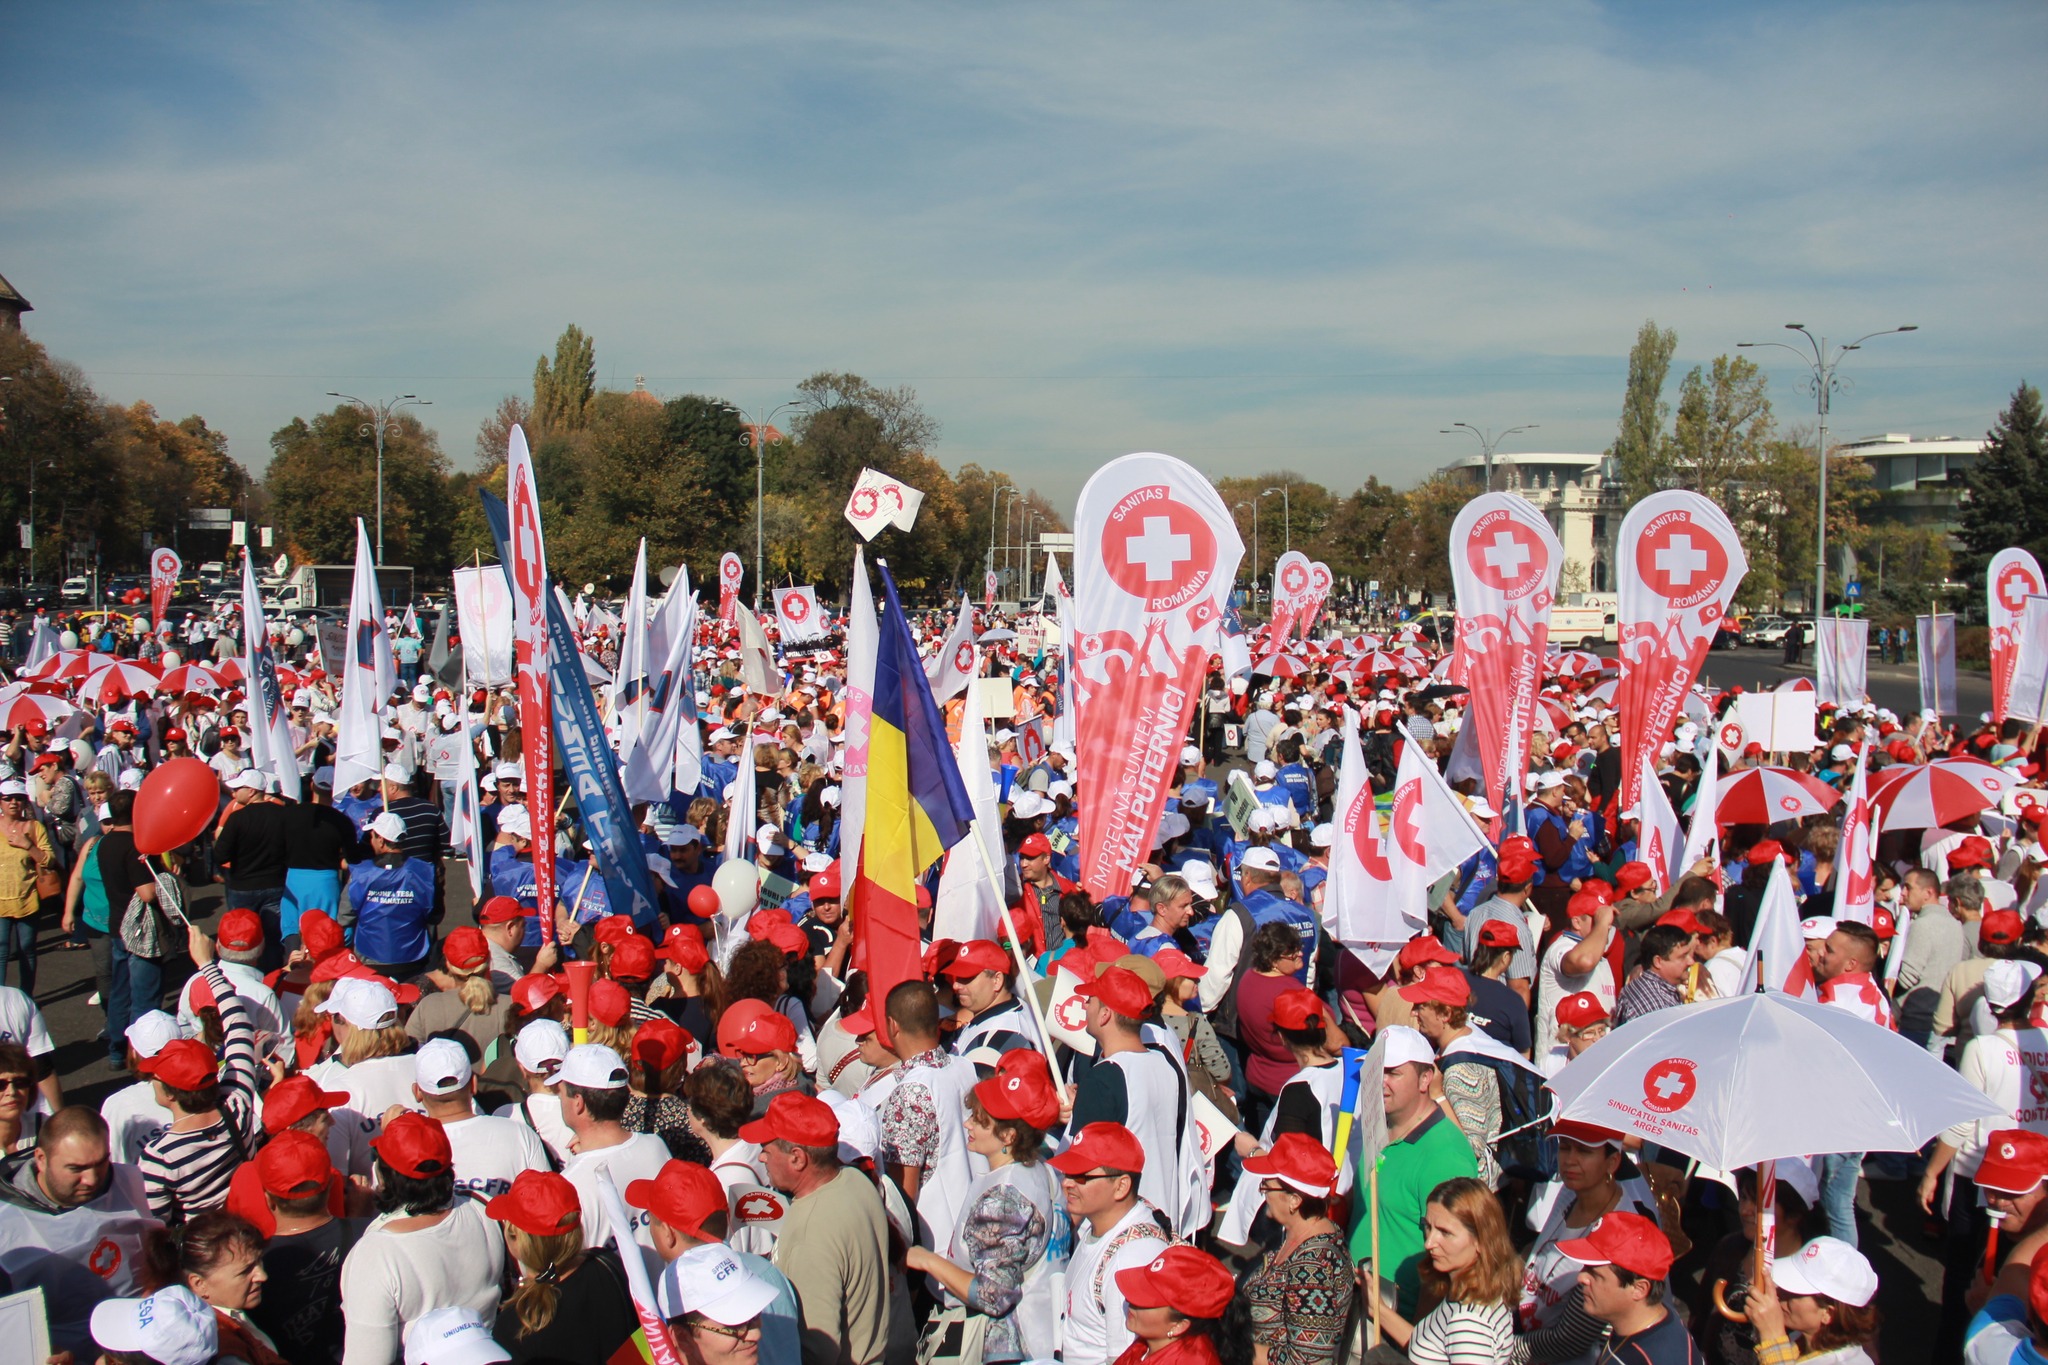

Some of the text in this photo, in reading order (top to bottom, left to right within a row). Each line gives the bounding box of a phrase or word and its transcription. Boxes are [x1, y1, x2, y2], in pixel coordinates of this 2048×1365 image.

[1113, 487, 1163, 522] SANITAS
[1472, 511, 1506, 538] SANITAS
[1645, 512, 1686, 538] SANITAS
[1152, 570, 1209, 610] ROMÂNIA
[1673, 579, 1720, 607] ROMÂNIA
[1516, 648, 1537, 744] PUTERNICI
[1115, 684, 1186, 872] MAI PUTERNICI
[1089, 705, 1156, 889] ÎMPREUNĂ SUNTEM
[1668, 1058, 1696, 1069] SANITAS
[1607, 1099, 1699, 1136] SINDICATUL SANITAS
[717, 1263, 738, 1281] CFR
[139, 1297, 154, 1329] ESA
[443, 1322, 471, 1338] UNIUNEA
